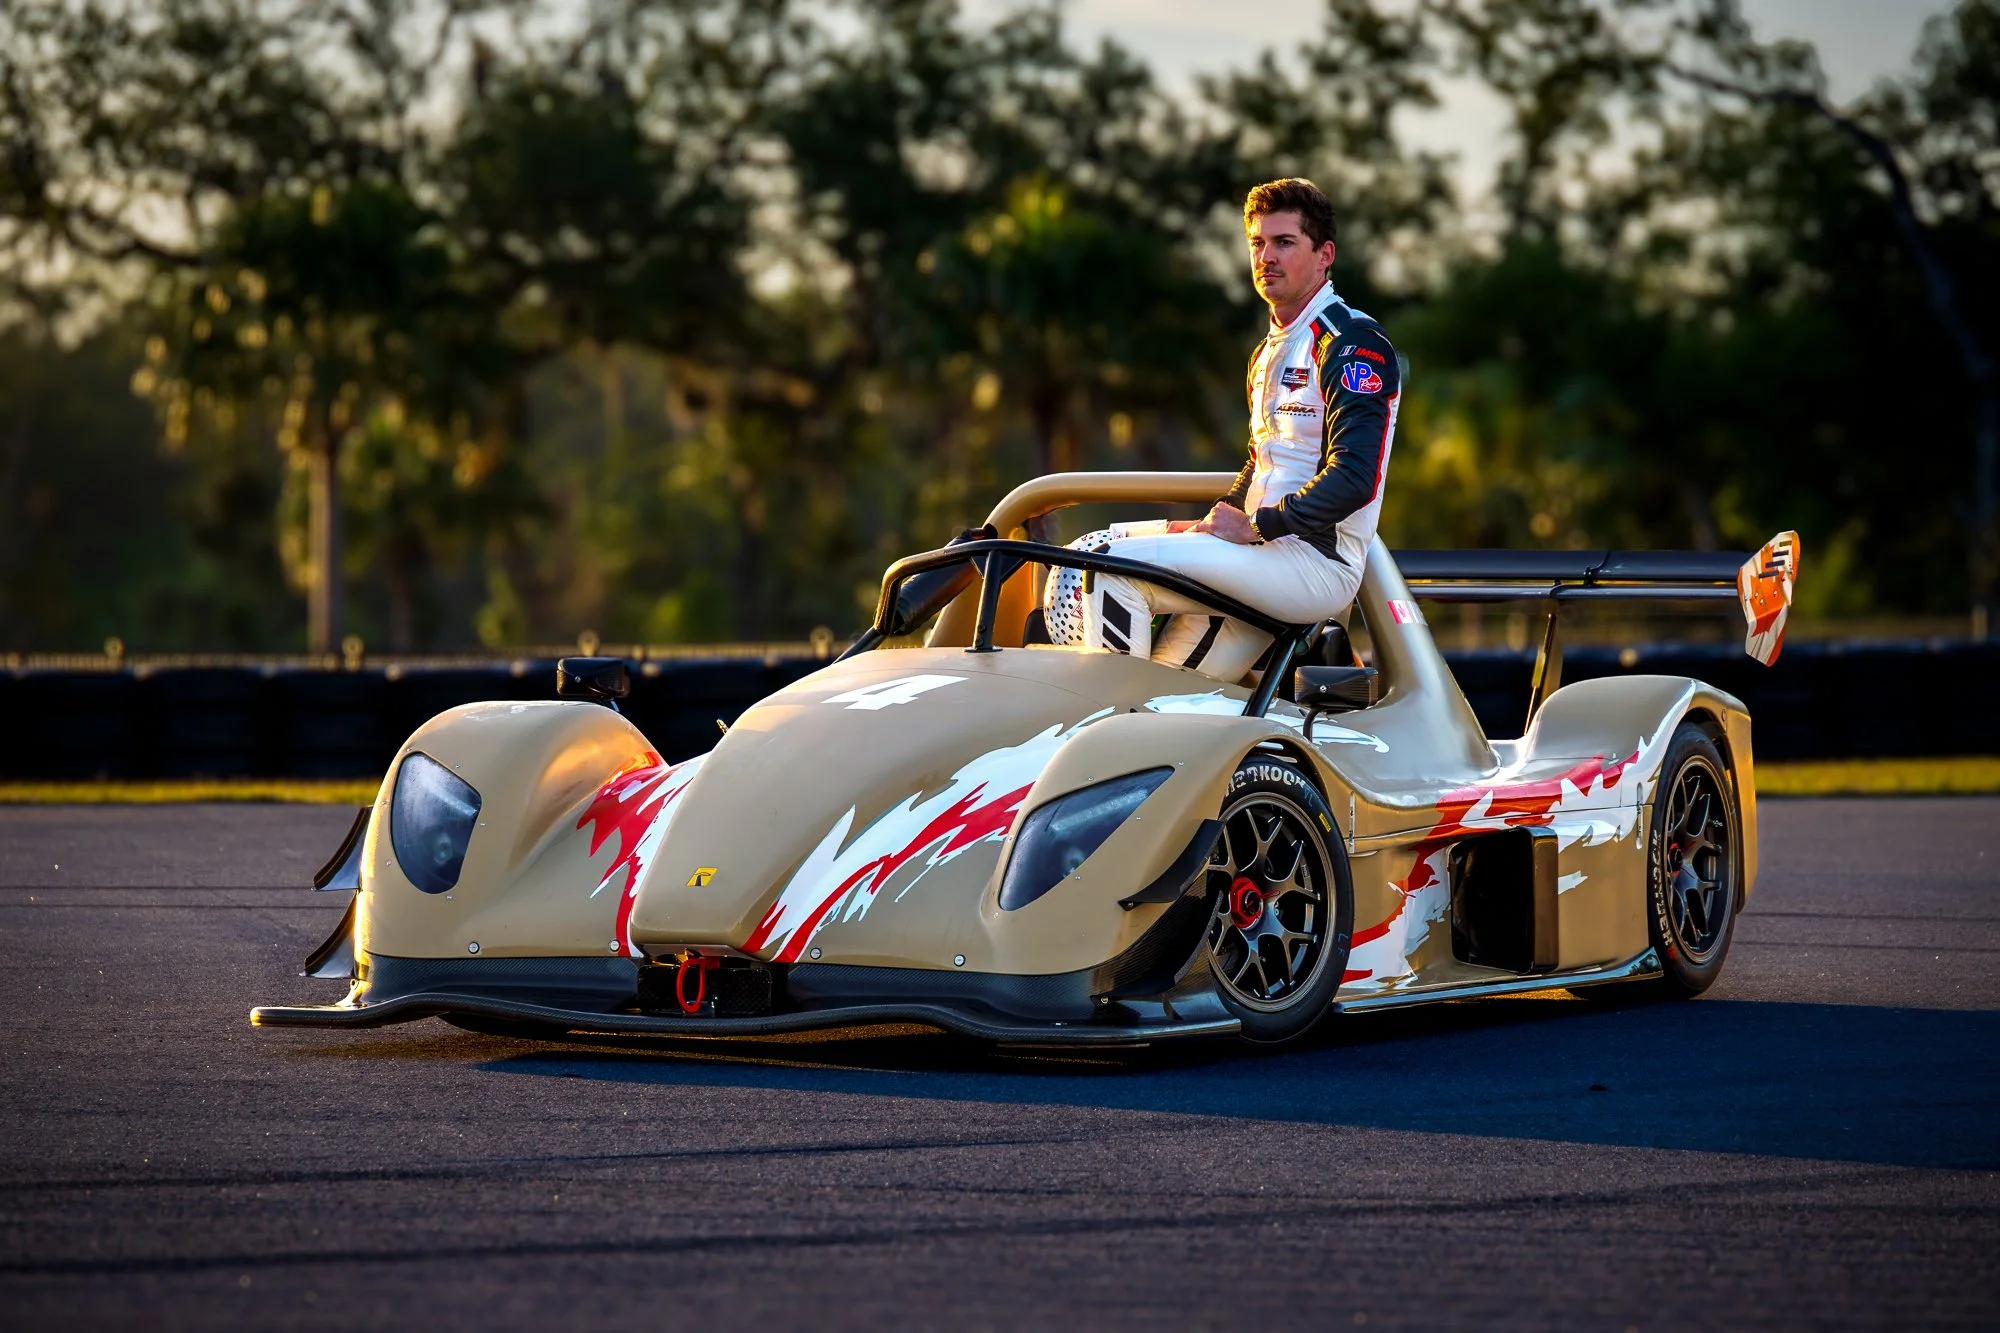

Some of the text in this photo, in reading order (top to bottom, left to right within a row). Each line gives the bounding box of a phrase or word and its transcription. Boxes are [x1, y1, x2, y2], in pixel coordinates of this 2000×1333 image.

[1355, 347, 1386, 365] IMSA
[1343, 361, 1373, 392] VP
[820, 674, 970, 711] 4
